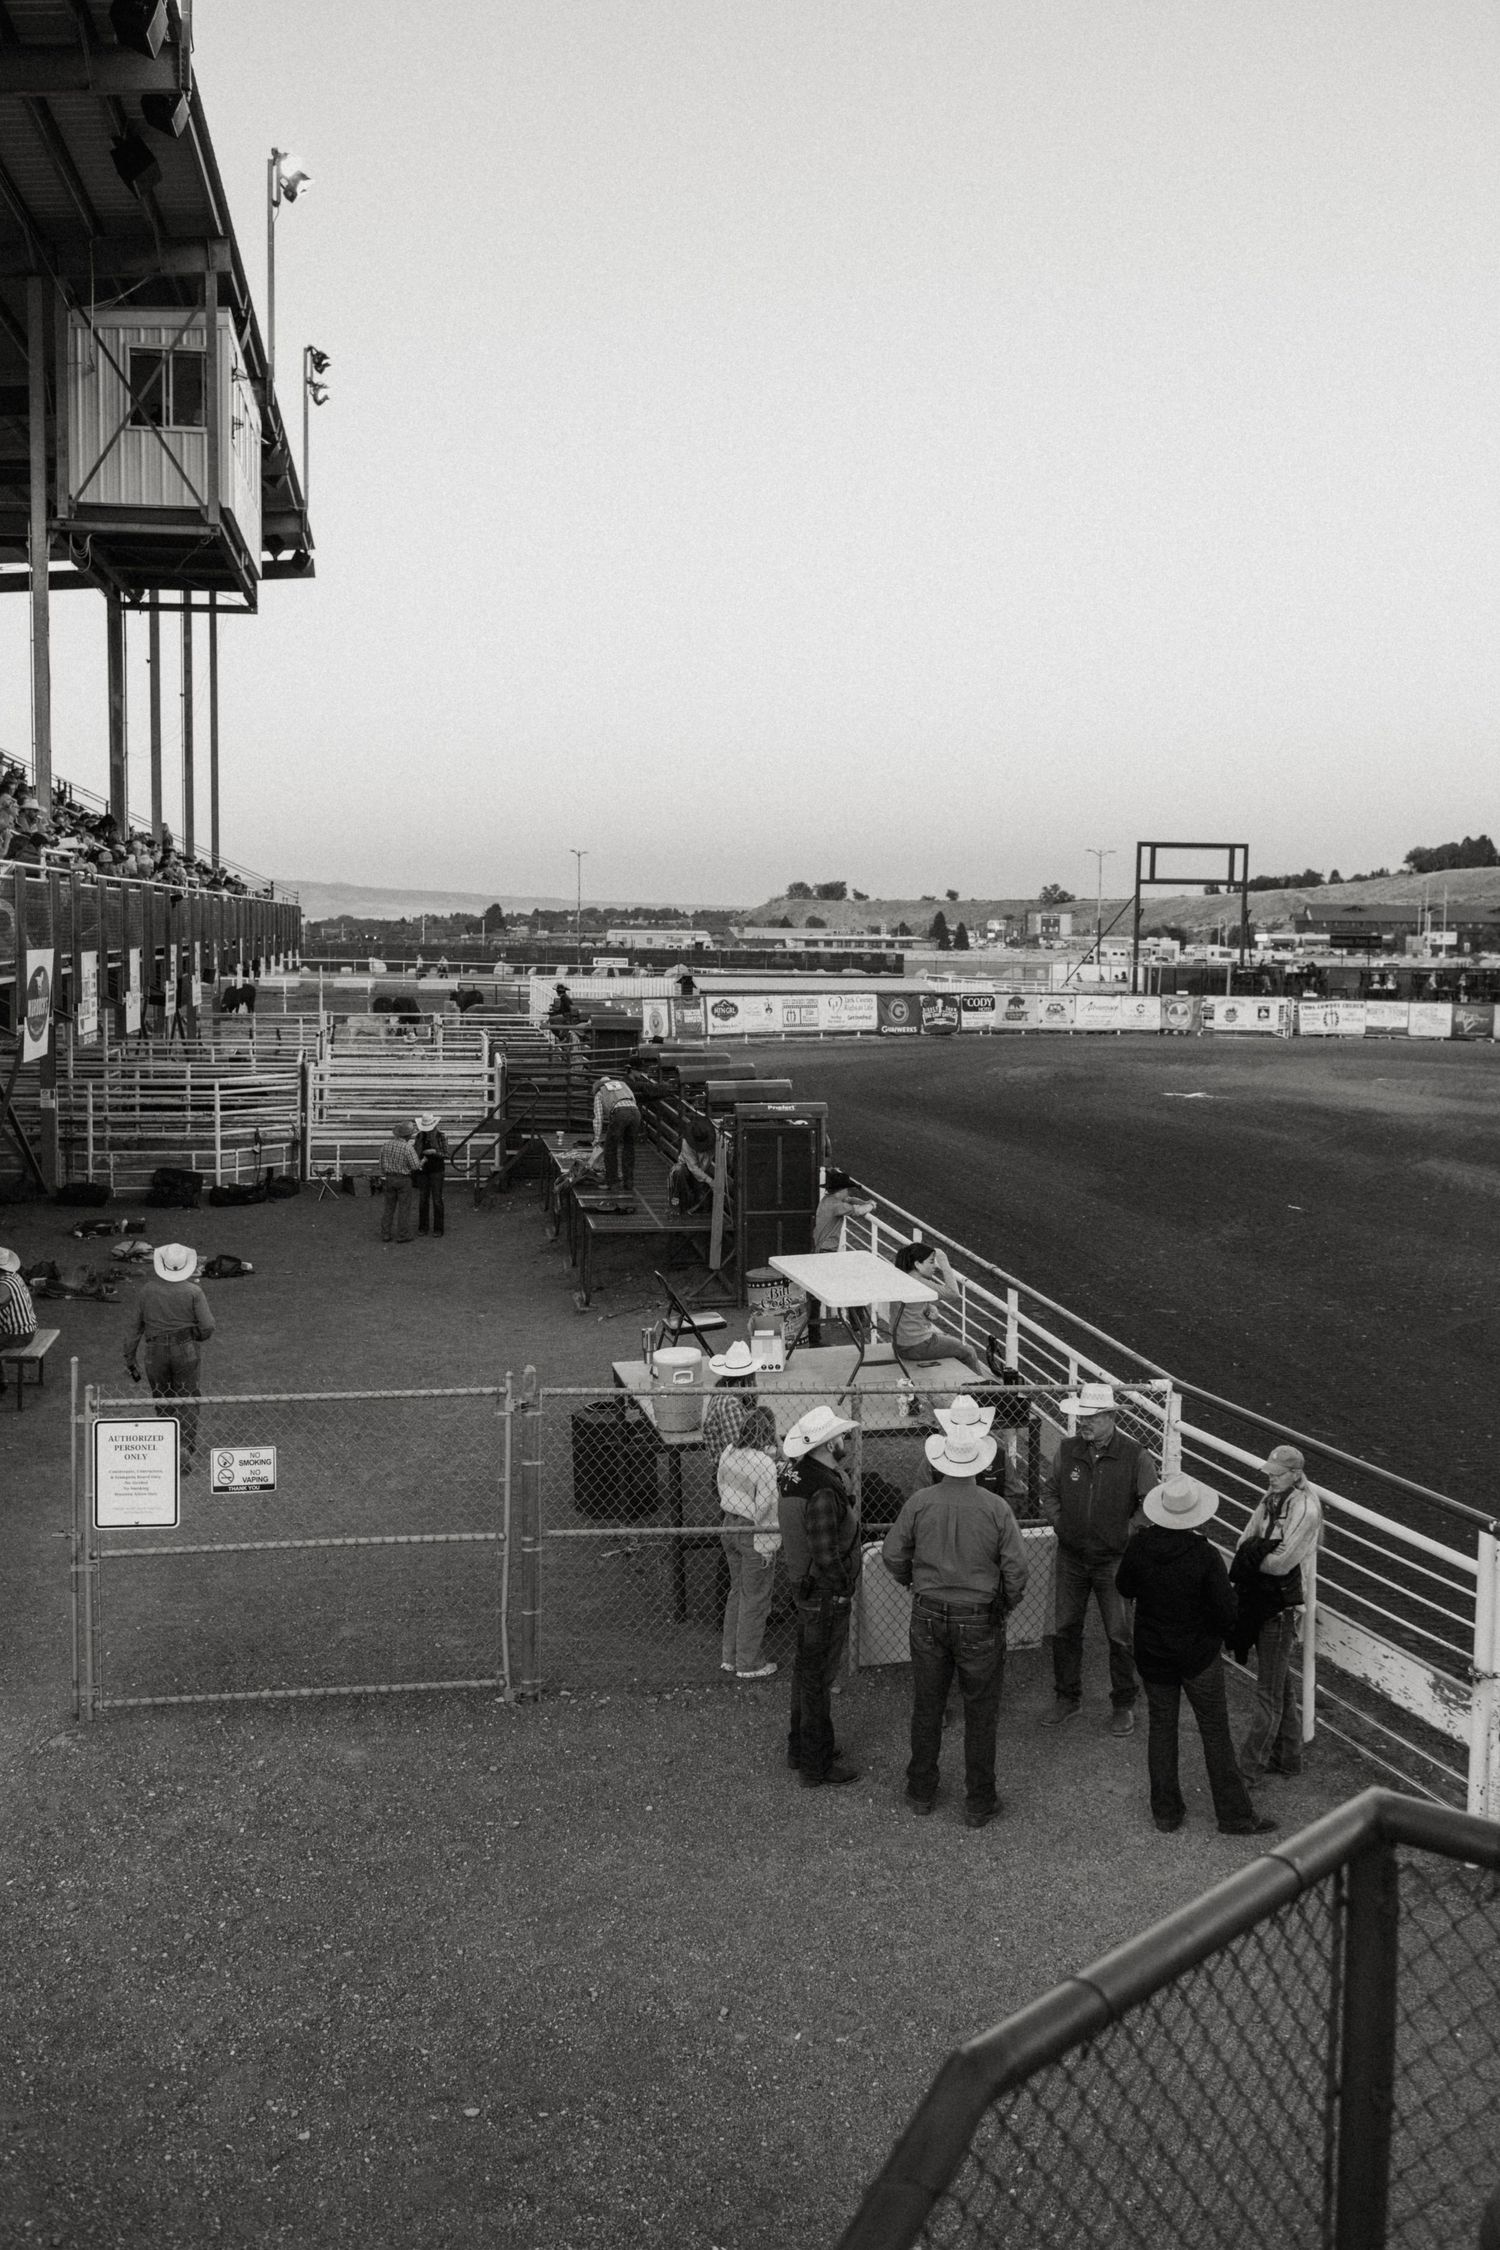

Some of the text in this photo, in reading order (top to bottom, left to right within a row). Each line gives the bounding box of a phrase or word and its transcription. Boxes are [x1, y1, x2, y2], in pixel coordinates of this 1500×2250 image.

[967, 997, 993, 1006] CODY
[881, 1025, 918, 1033] GUNWERKS
[768, 1286, 790, 1299] Bill
[760, 1296, 793, 1309] Cody
[249, 1451, 261, 1459] NO
[238, 1458, 272, 1466] SMOKING
[242, 1475, 269, 1483] VAPING
